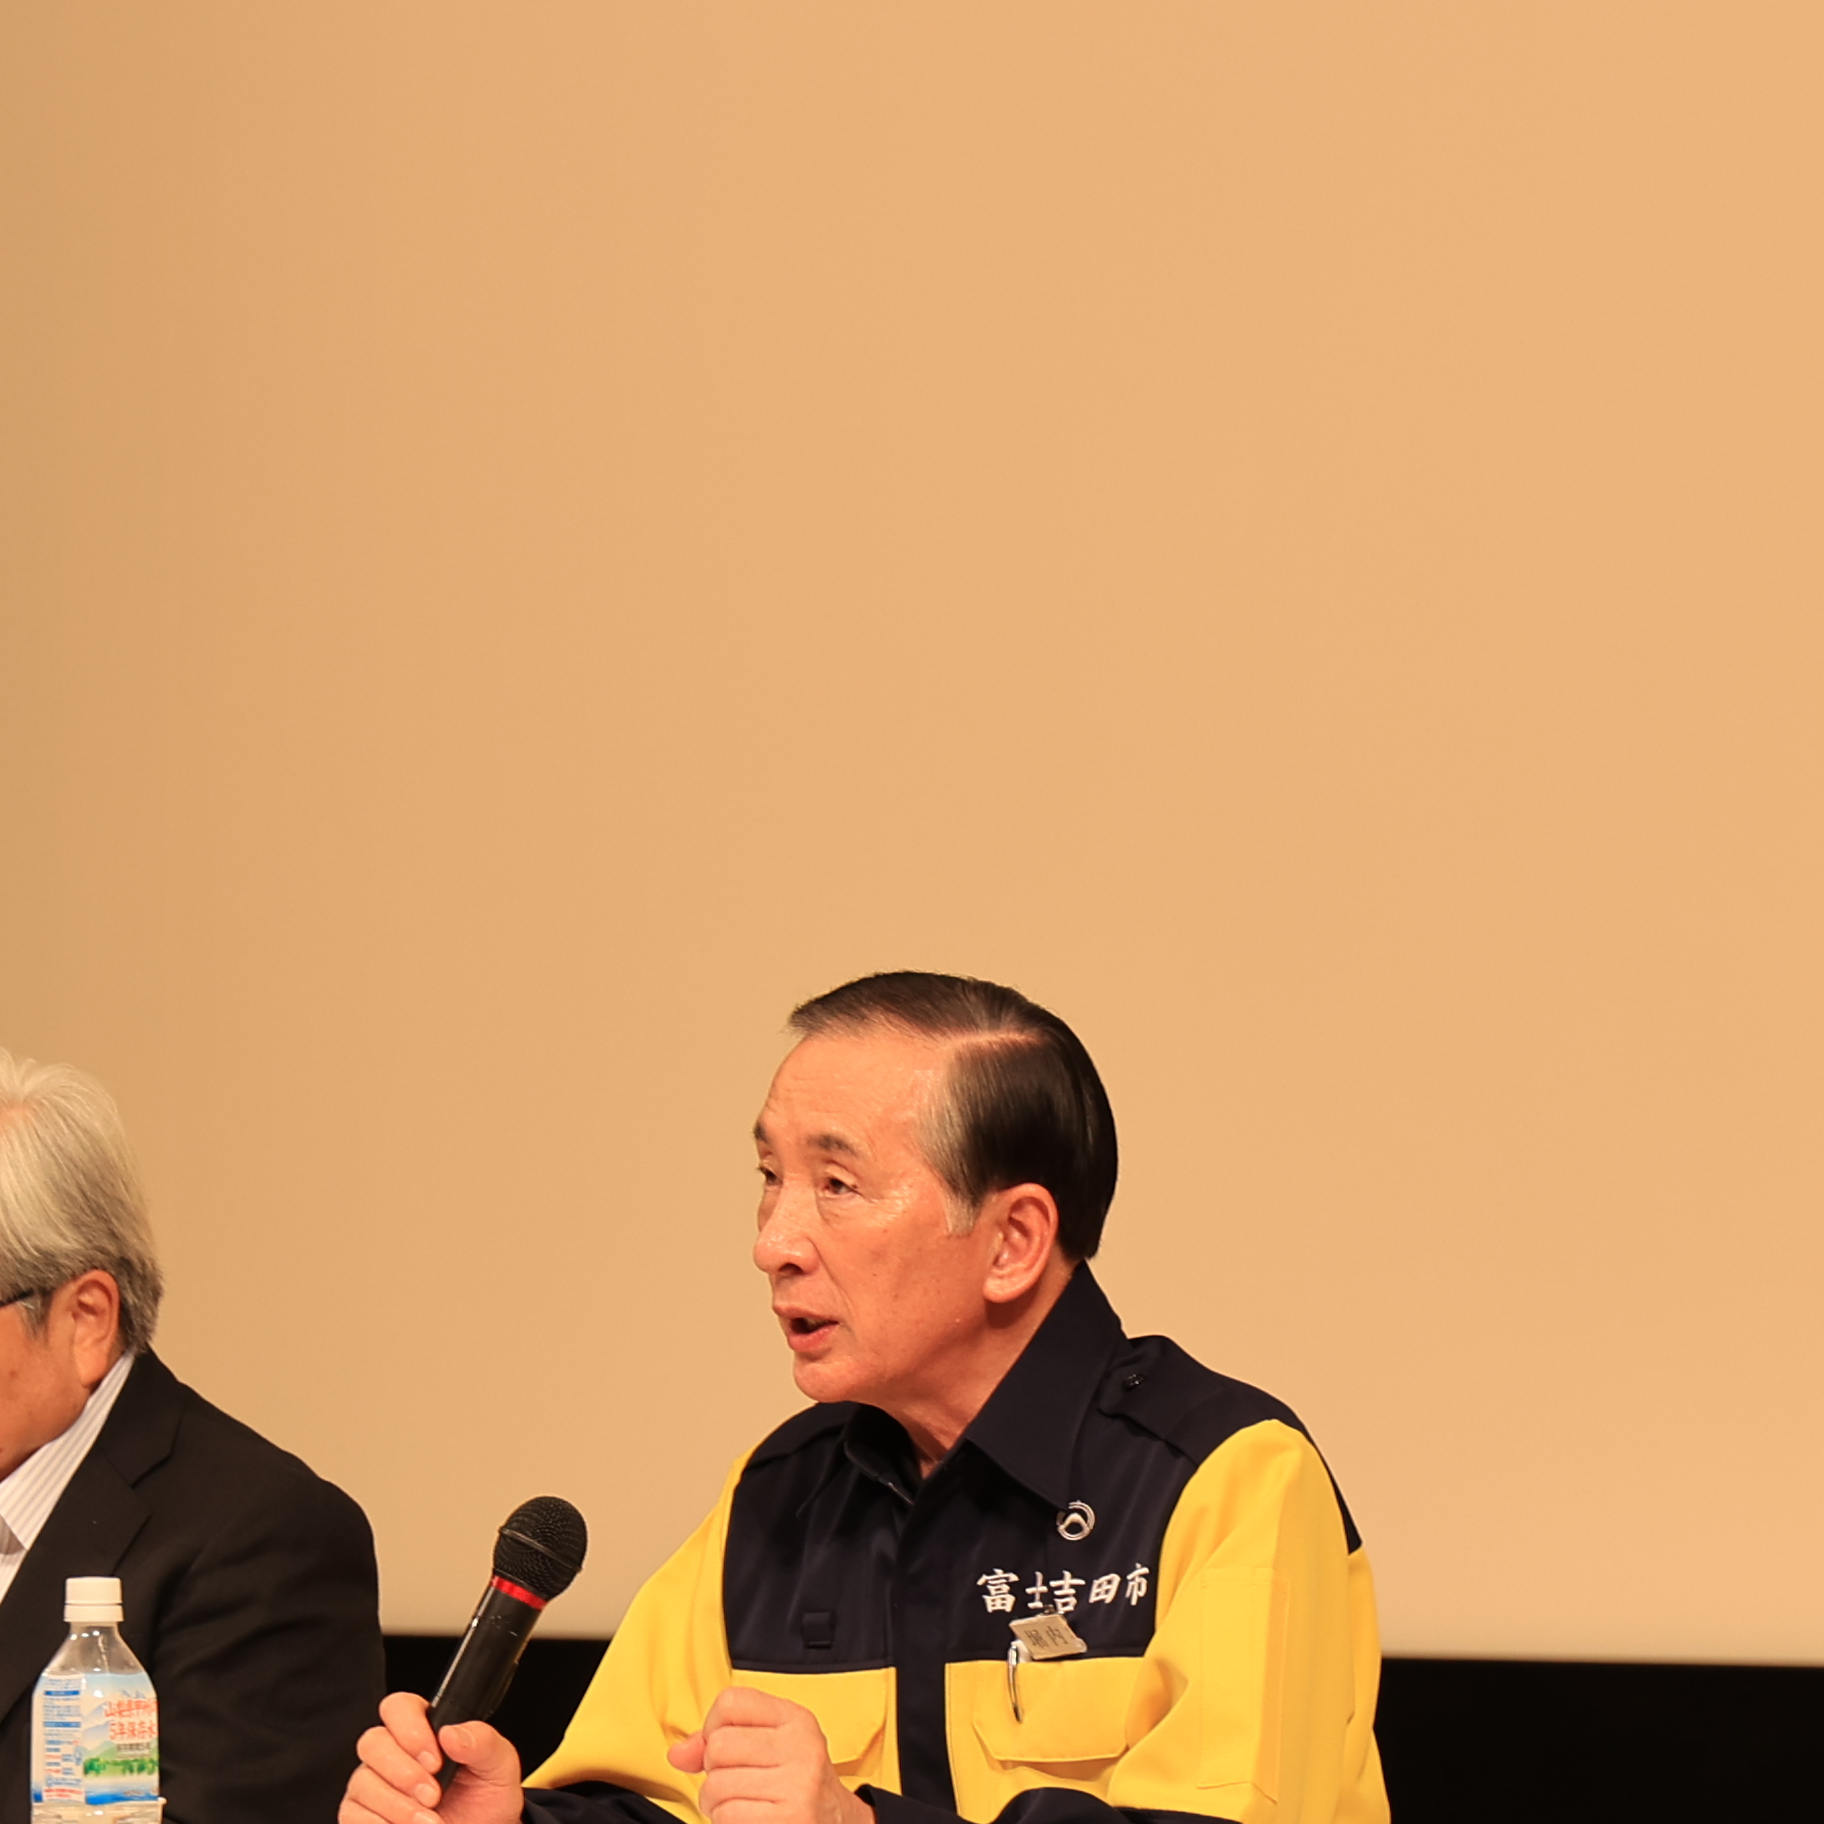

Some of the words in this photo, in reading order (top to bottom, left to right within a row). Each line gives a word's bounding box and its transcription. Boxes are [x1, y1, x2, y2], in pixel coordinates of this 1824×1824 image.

[976, 1563, 1150, 1614] 富士吉田市
